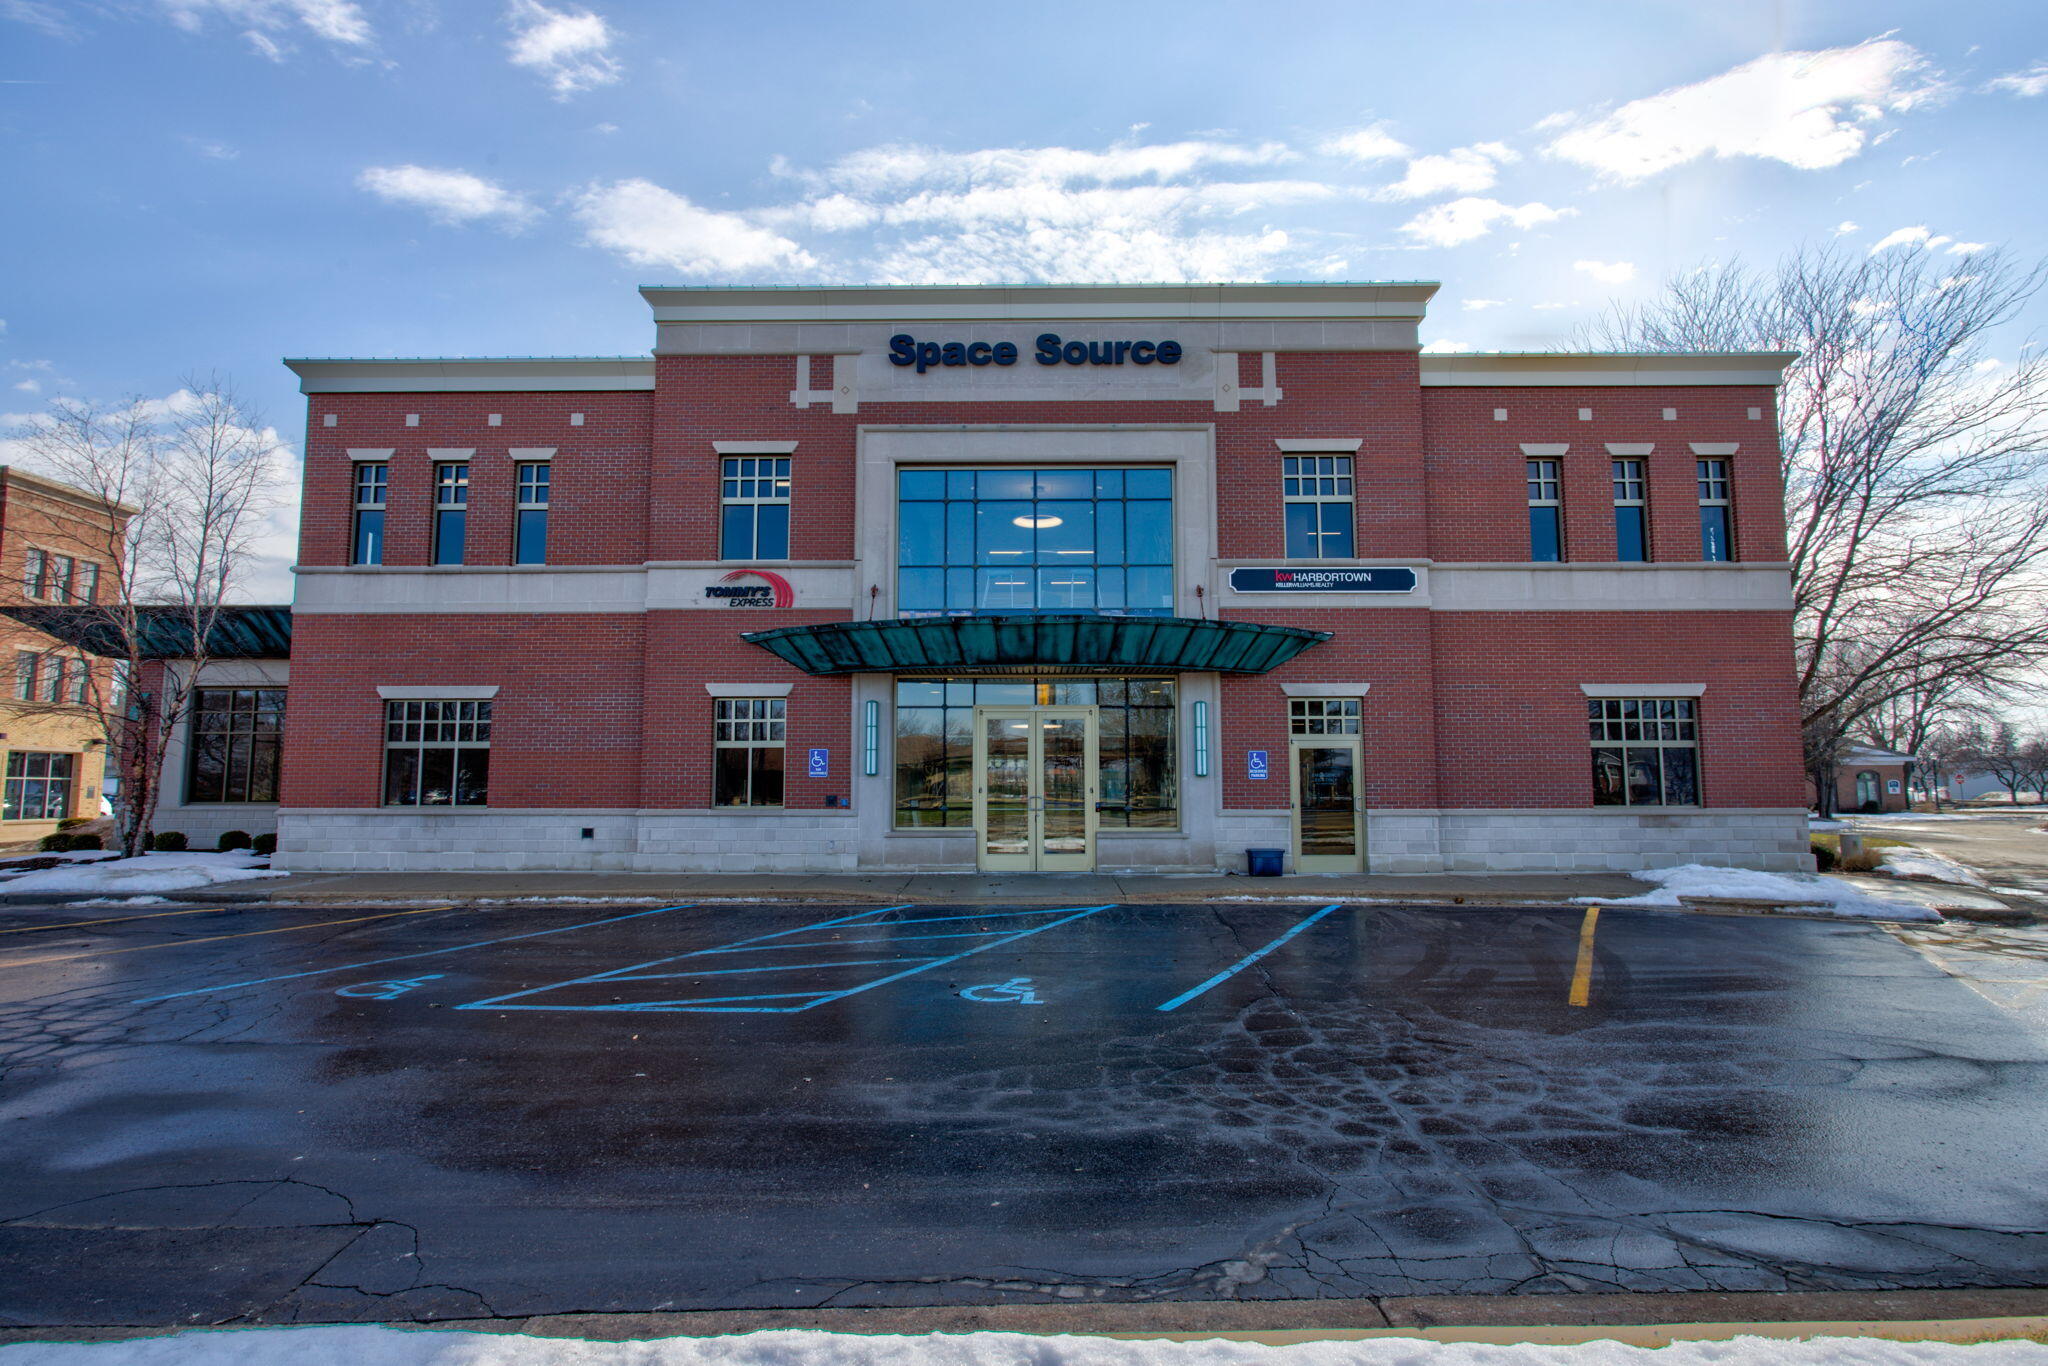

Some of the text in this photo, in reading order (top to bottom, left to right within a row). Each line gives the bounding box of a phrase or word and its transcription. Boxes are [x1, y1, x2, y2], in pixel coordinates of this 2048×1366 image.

[888, 333, 1182, 374] Space Source
[705, 586, 771, 598] TOMMY'S
[729, 598, 774, 608] EXPRESS
